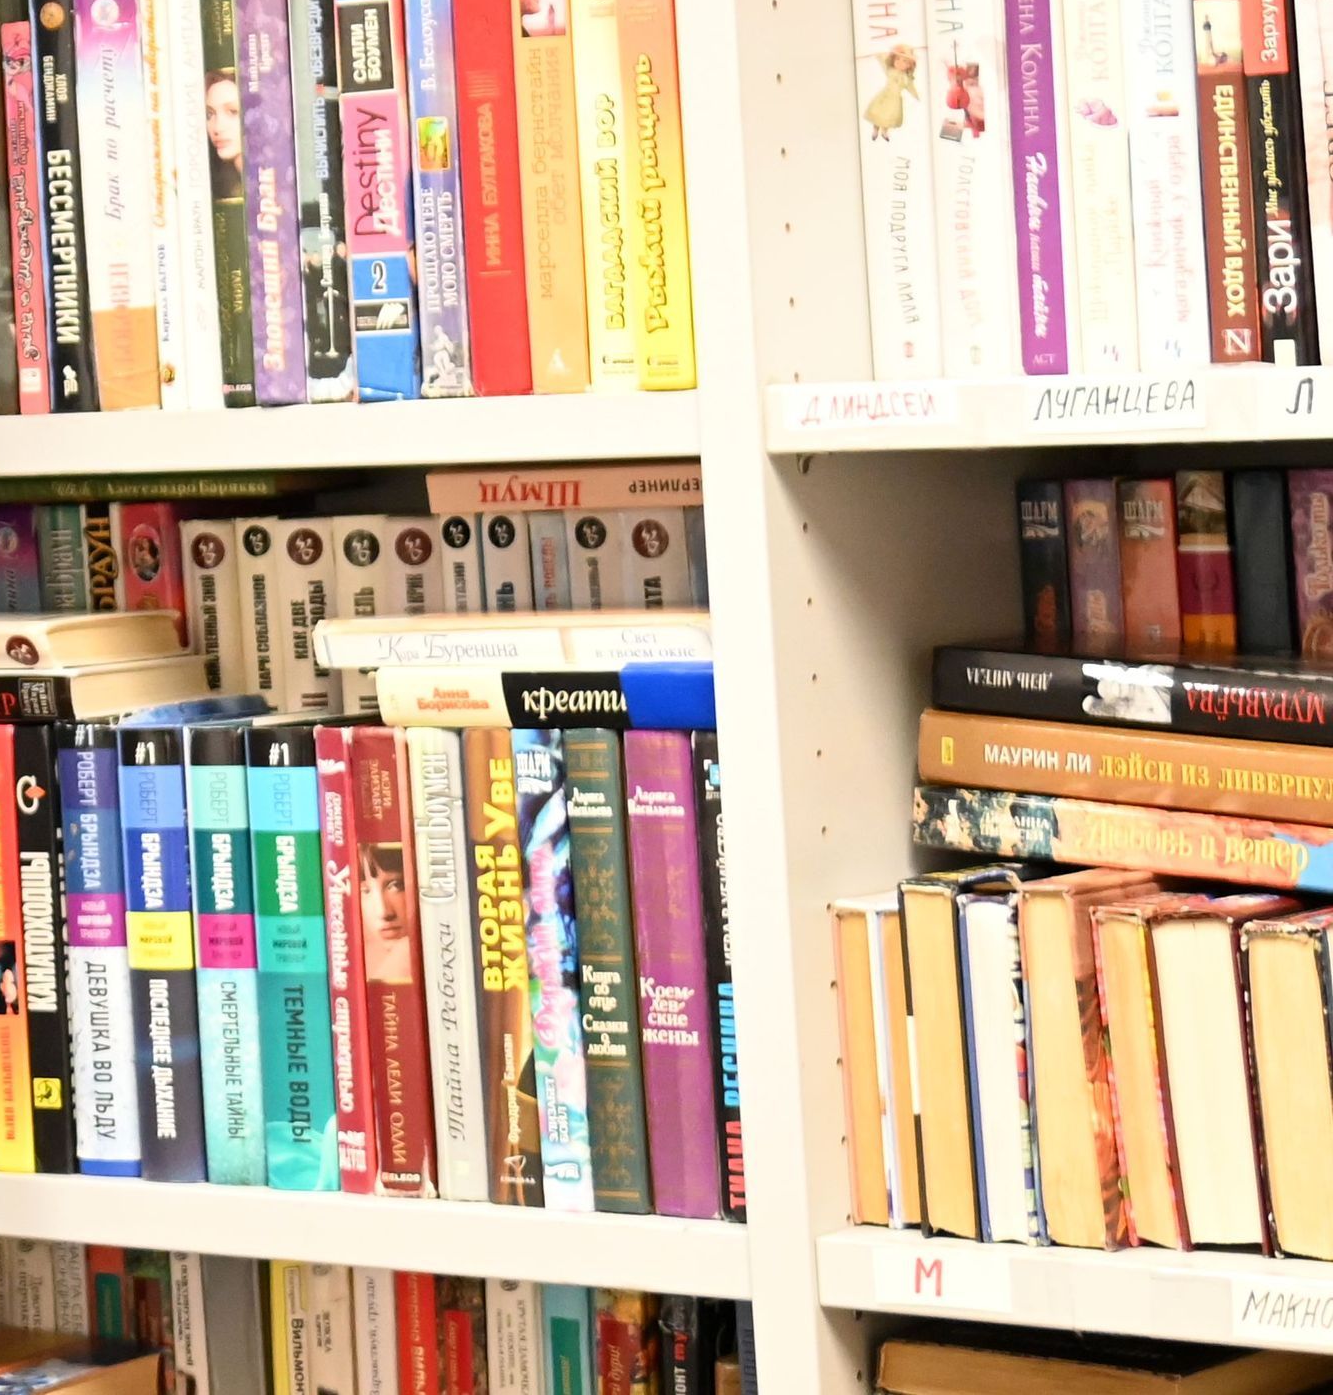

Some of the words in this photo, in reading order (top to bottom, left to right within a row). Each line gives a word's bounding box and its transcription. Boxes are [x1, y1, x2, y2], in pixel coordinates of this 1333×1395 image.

[351, 24, 368, 82] САЛЛИ
[365, 8, 380, 81] БОУМЕН
[42, 55, 56, 122] БЕНДЖАМИН
[55, 73, 68, 101] ХЛОЯ
[148, 91, 161, 113] на
[421, 73, 435, 90] В.
[528, 47, 549, 175] бернстайн
[105, 138, 119, 160] по
[313, 96, 329, 179] ВЫЧИСЛИТЬ
[598, 93, 616, 146] ВОР
[632, 53, 665, 190] рыцарь
[353, 107, 388, 236] Destiny
[374, 128, 402, 236] Дестини
[478, 102, 498, 205] БУЛГАКОВА
[894, 156, 910, 193] МОЯ
[1213, 84, 1242, 254] ЕДИНСТВЕННЫЙ
[103, 173, 123, 220] Брак
[421, 187, 436, 226] ТЕБЕ
[438, 191, 455, 259] СМЕРТЬ
[1260, 185, 1279, 216] Мне
[47, 149, 80, 343] БЕССМЕРТНИКИ
[484, 213, 500, 265] ИННА
[534, 185, 554, 299] марселла
[594, 158, 626, 329] БАГДАДСКИЙ
[637, 198, 668, 332] Рыжий
[888, 199, 912, 275] ПОДРУГА
[1263, 218, 1302, 315] Зари
[156, 244, 166, 292] БАГРОВ
[371, 261, 387, 293] 2
[423, 232, 441, 313] ПРОЩАЮ
[442, 263, 458, 306] МОЮ
[1224, 256, 1246, 317] ВДОХ
[900, 281, 921, 325] ЛИЛЯ
[1033, 380, 1198, 420] ЛУГАНЦЕВА
[480, 478, 582, 507] Шмуц
[417, 697, 490, 711] Борисова
[432, 688, 469, 700] Анна
[77, 750, 96, 807] РОБЕРТ
[983, 744, 1059, 769] МАУРИН
[1065, 751, 1092, 772] ЛИ
[138, 772, 156, 823] РОБЕРТ
[210, 772, 228, 824] РОБЕРТ
[273, 773, 292, 825] РОБЕРТ
[414, 752, 461, 833] Боумен
[80, 813, 100, 888] БРЫНДЗА
[141, 833, 162, 908] БРЫНДЗА
[212, 833, 233, 910] БРЫНДЗА
[276, 835, 299, 913] БРЫНДЗА
[420, 837, 458, 904] Салли
[19, 851, 57, 1012] КАНАТОХОДЦЫ
[475, 844, 504, 991] ВТОРАЯ
[495, 844, 524, 991] ЖИЗНЬ
[583, 964, 621, 986] Книга
[85, 961, 111, 1052] ДЕВУШКА
[149, 979, 172, 1063] ПОСЛЕДНЕЕ
[219, 980, 241, 1086] СМЕРТЕЛЬНЫЕ
[283, 985, 306, 1074] ТЕМНЫЕ
[382, 992, 400, 1051] ТАЙНА
[582, 1013, 628, 1034] Сказки
[92, 1060, 112, 1082] ВО
[386, 1058, 402, 1105] ЛЕДИ
[501, 1033, 515, 1081] Бакман
[94, 1090, 116, 1140] ЛЬДУ
[154, 1066, 176, 1139] ДЫХАНИЕ
[225, 1092, 246, 1139] ТАЙНЫ
[289, 1081, 311, 1144] ВОДЫ
[445, 1042, 466, 1141] Тайна
[390, 1112, 407, 1164] ОДЛИ
[913, 1256, 943, 1297] М
